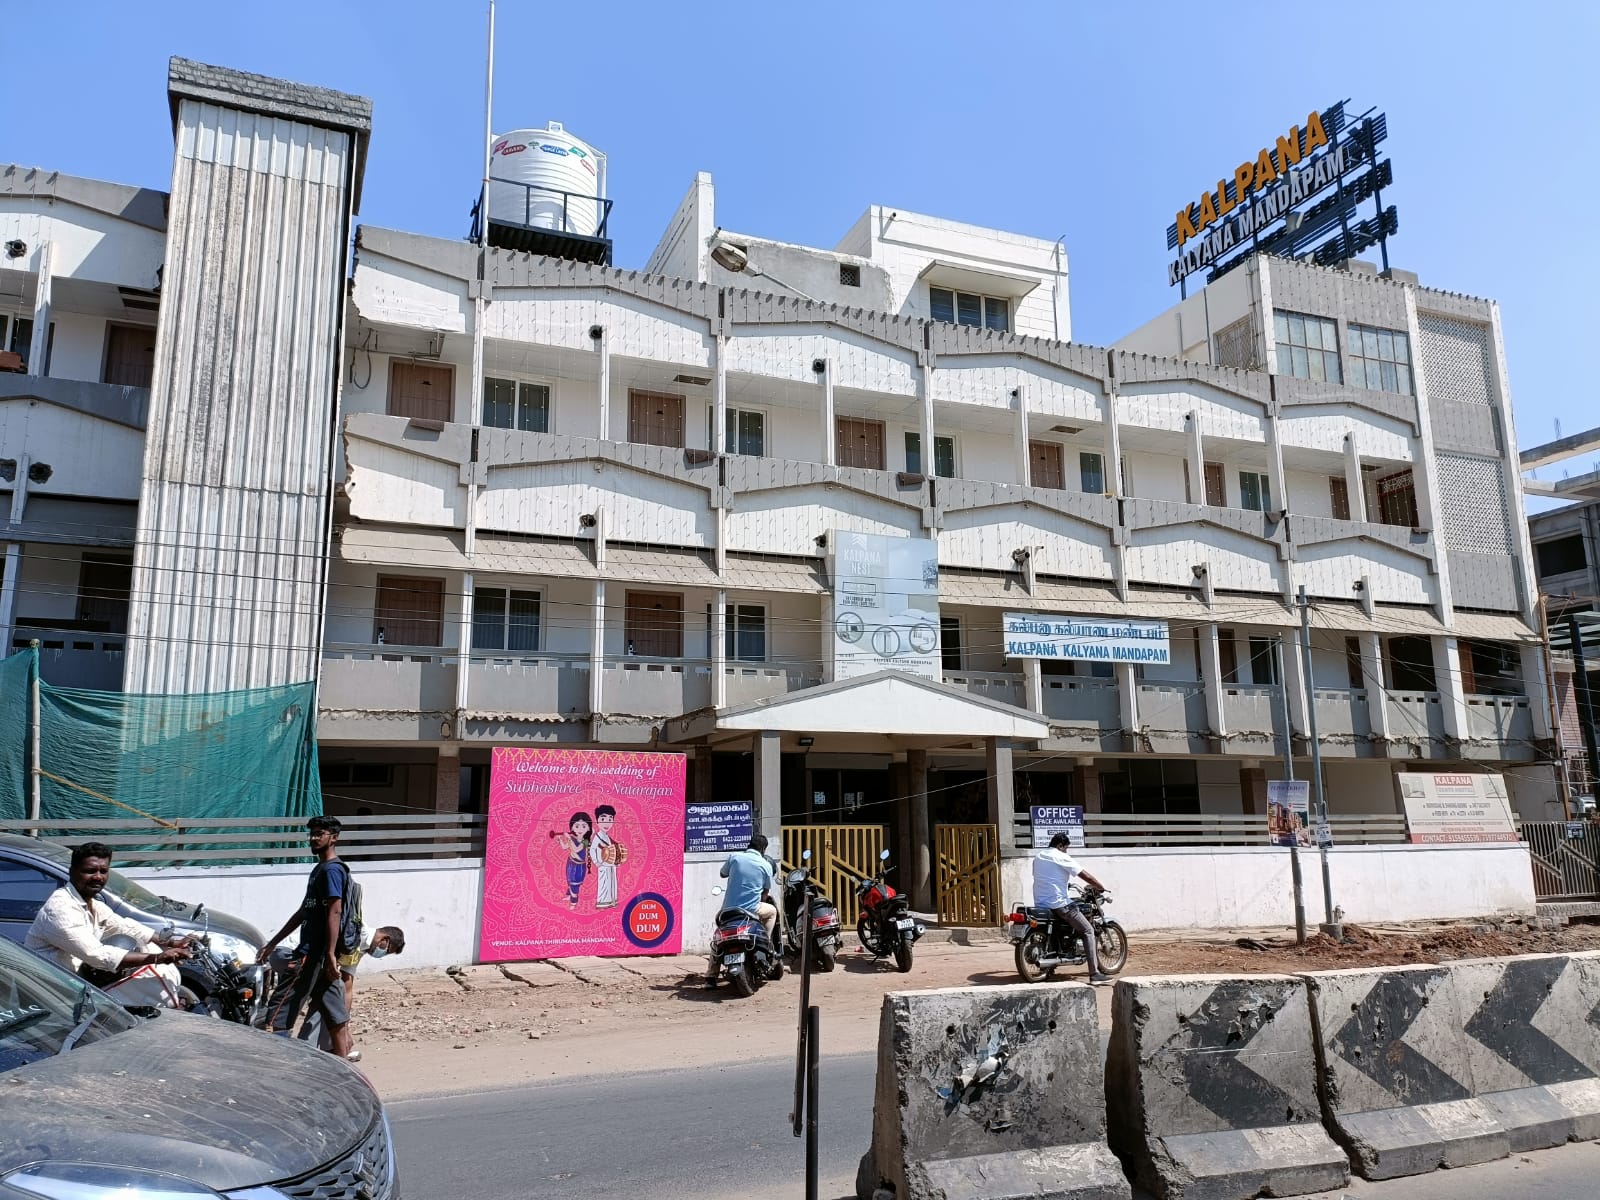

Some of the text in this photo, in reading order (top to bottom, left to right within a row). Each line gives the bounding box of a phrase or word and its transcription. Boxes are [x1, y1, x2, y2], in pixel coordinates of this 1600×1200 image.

[1176, 110, 1329, 246] KALPANA
[1167, 145, 1345, 286] KALYANA MANDAPAM
[843, 548, 881, 566] KALPANA
[851, 562, 871, 576] NEST
[1008, 641, 1168, 662] KALPANA KALYANA MANDAPAM
[516, 761, 659, 779] Welcome to the wedding of
[1436, 776, 1472, 784] KALPANA
[505, 780, 674, 799] Subhashree Natarajan
[1038, 807, 1075, 817] OFFICE
[638, 912, 659, 921] DUM
[636, 924, 660, 934] DUM
